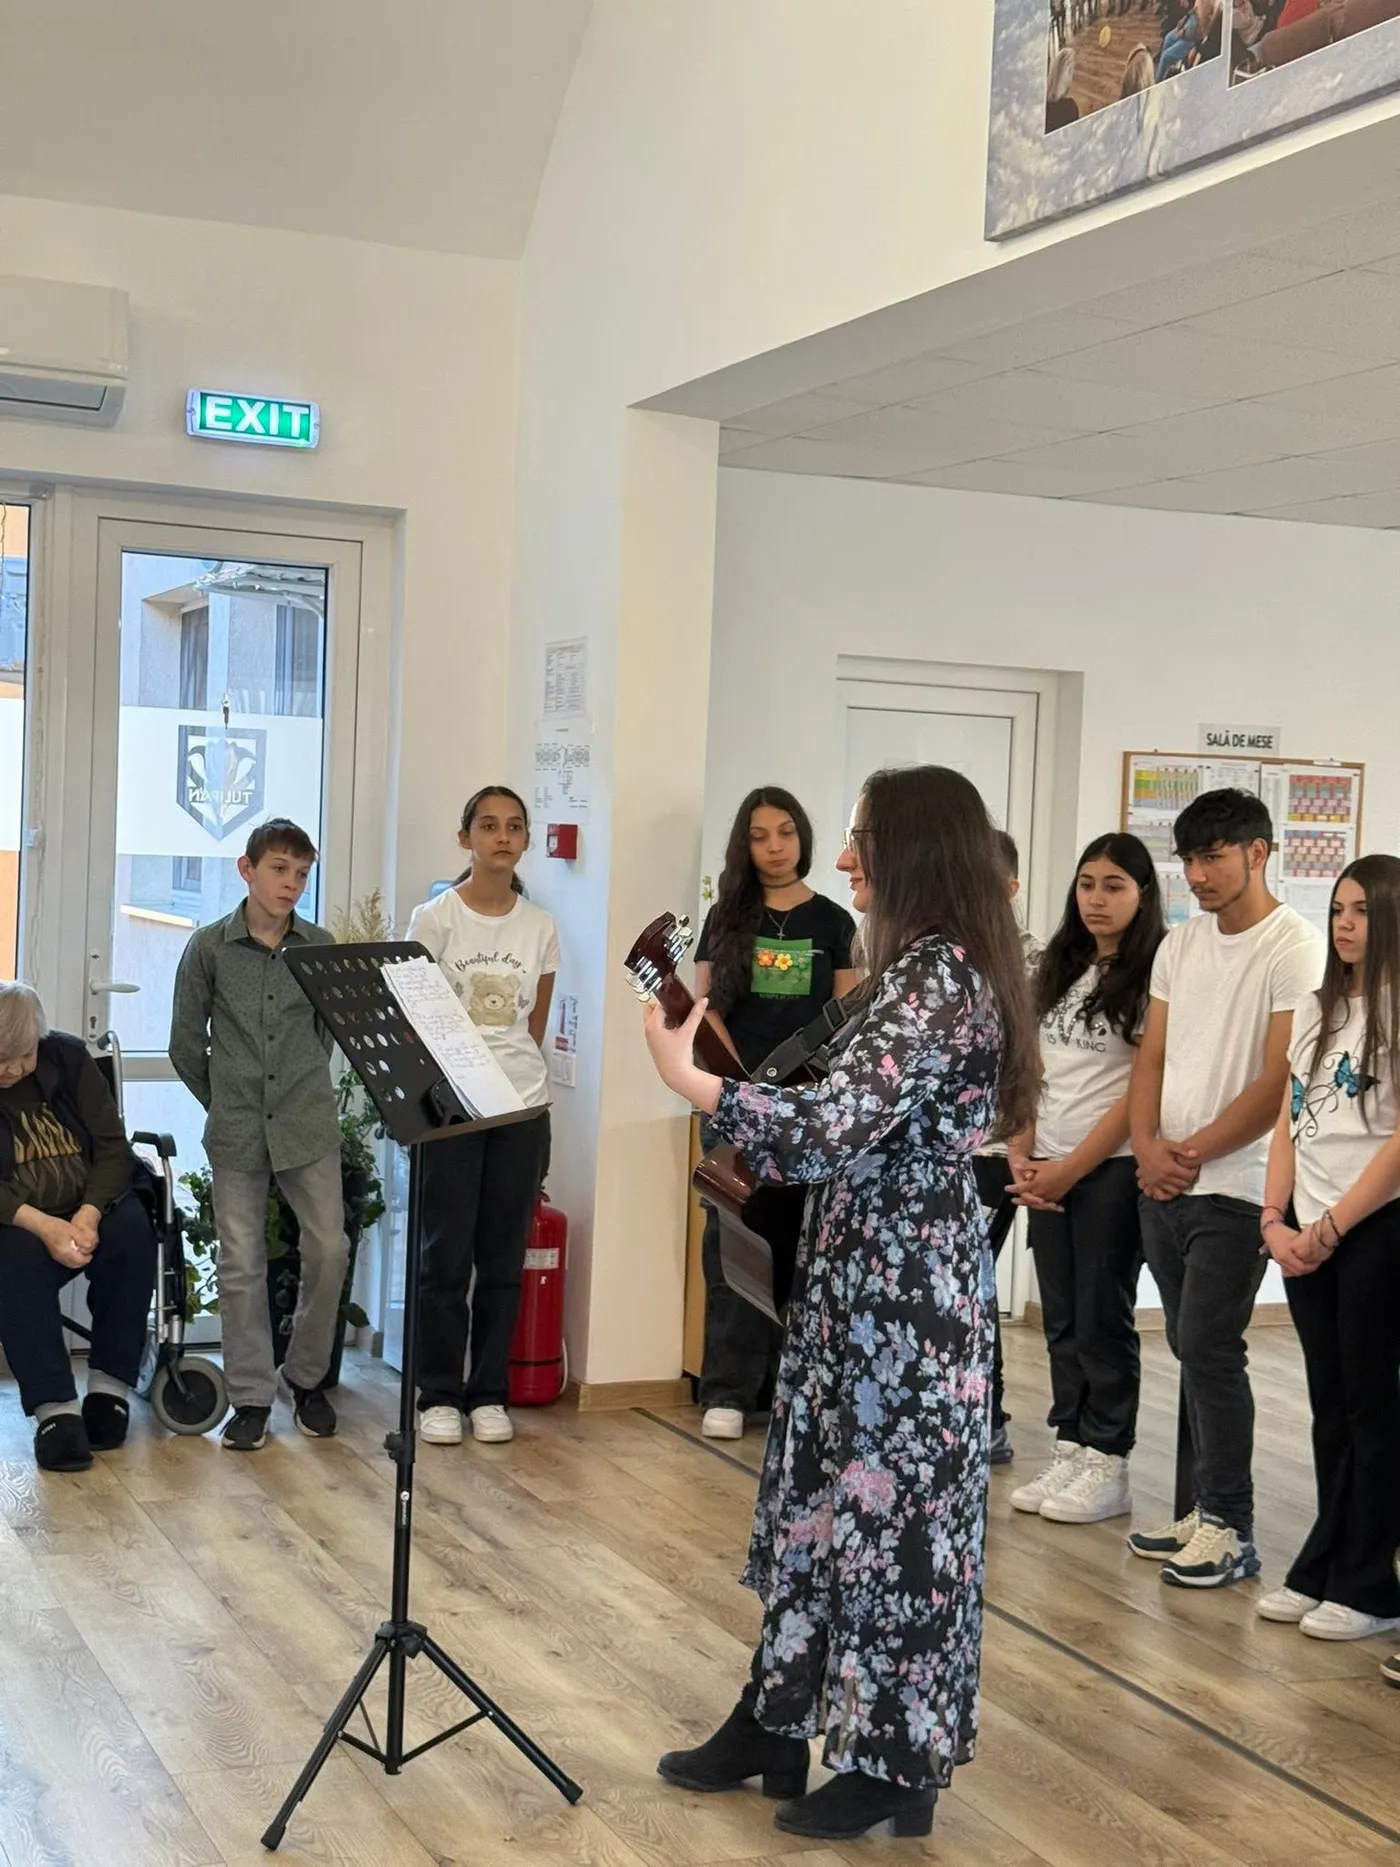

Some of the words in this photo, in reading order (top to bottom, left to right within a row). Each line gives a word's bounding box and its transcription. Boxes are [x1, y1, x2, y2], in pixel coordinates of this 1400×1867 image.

[205, 396, 310, 437] EXIT
[1232, 734, 1246, 747] DE
[1247, 734, 1274, 749] MESE
[454, 951, 499, 972] Beautiful
[1076, 1038, 1106, 1053] KING
